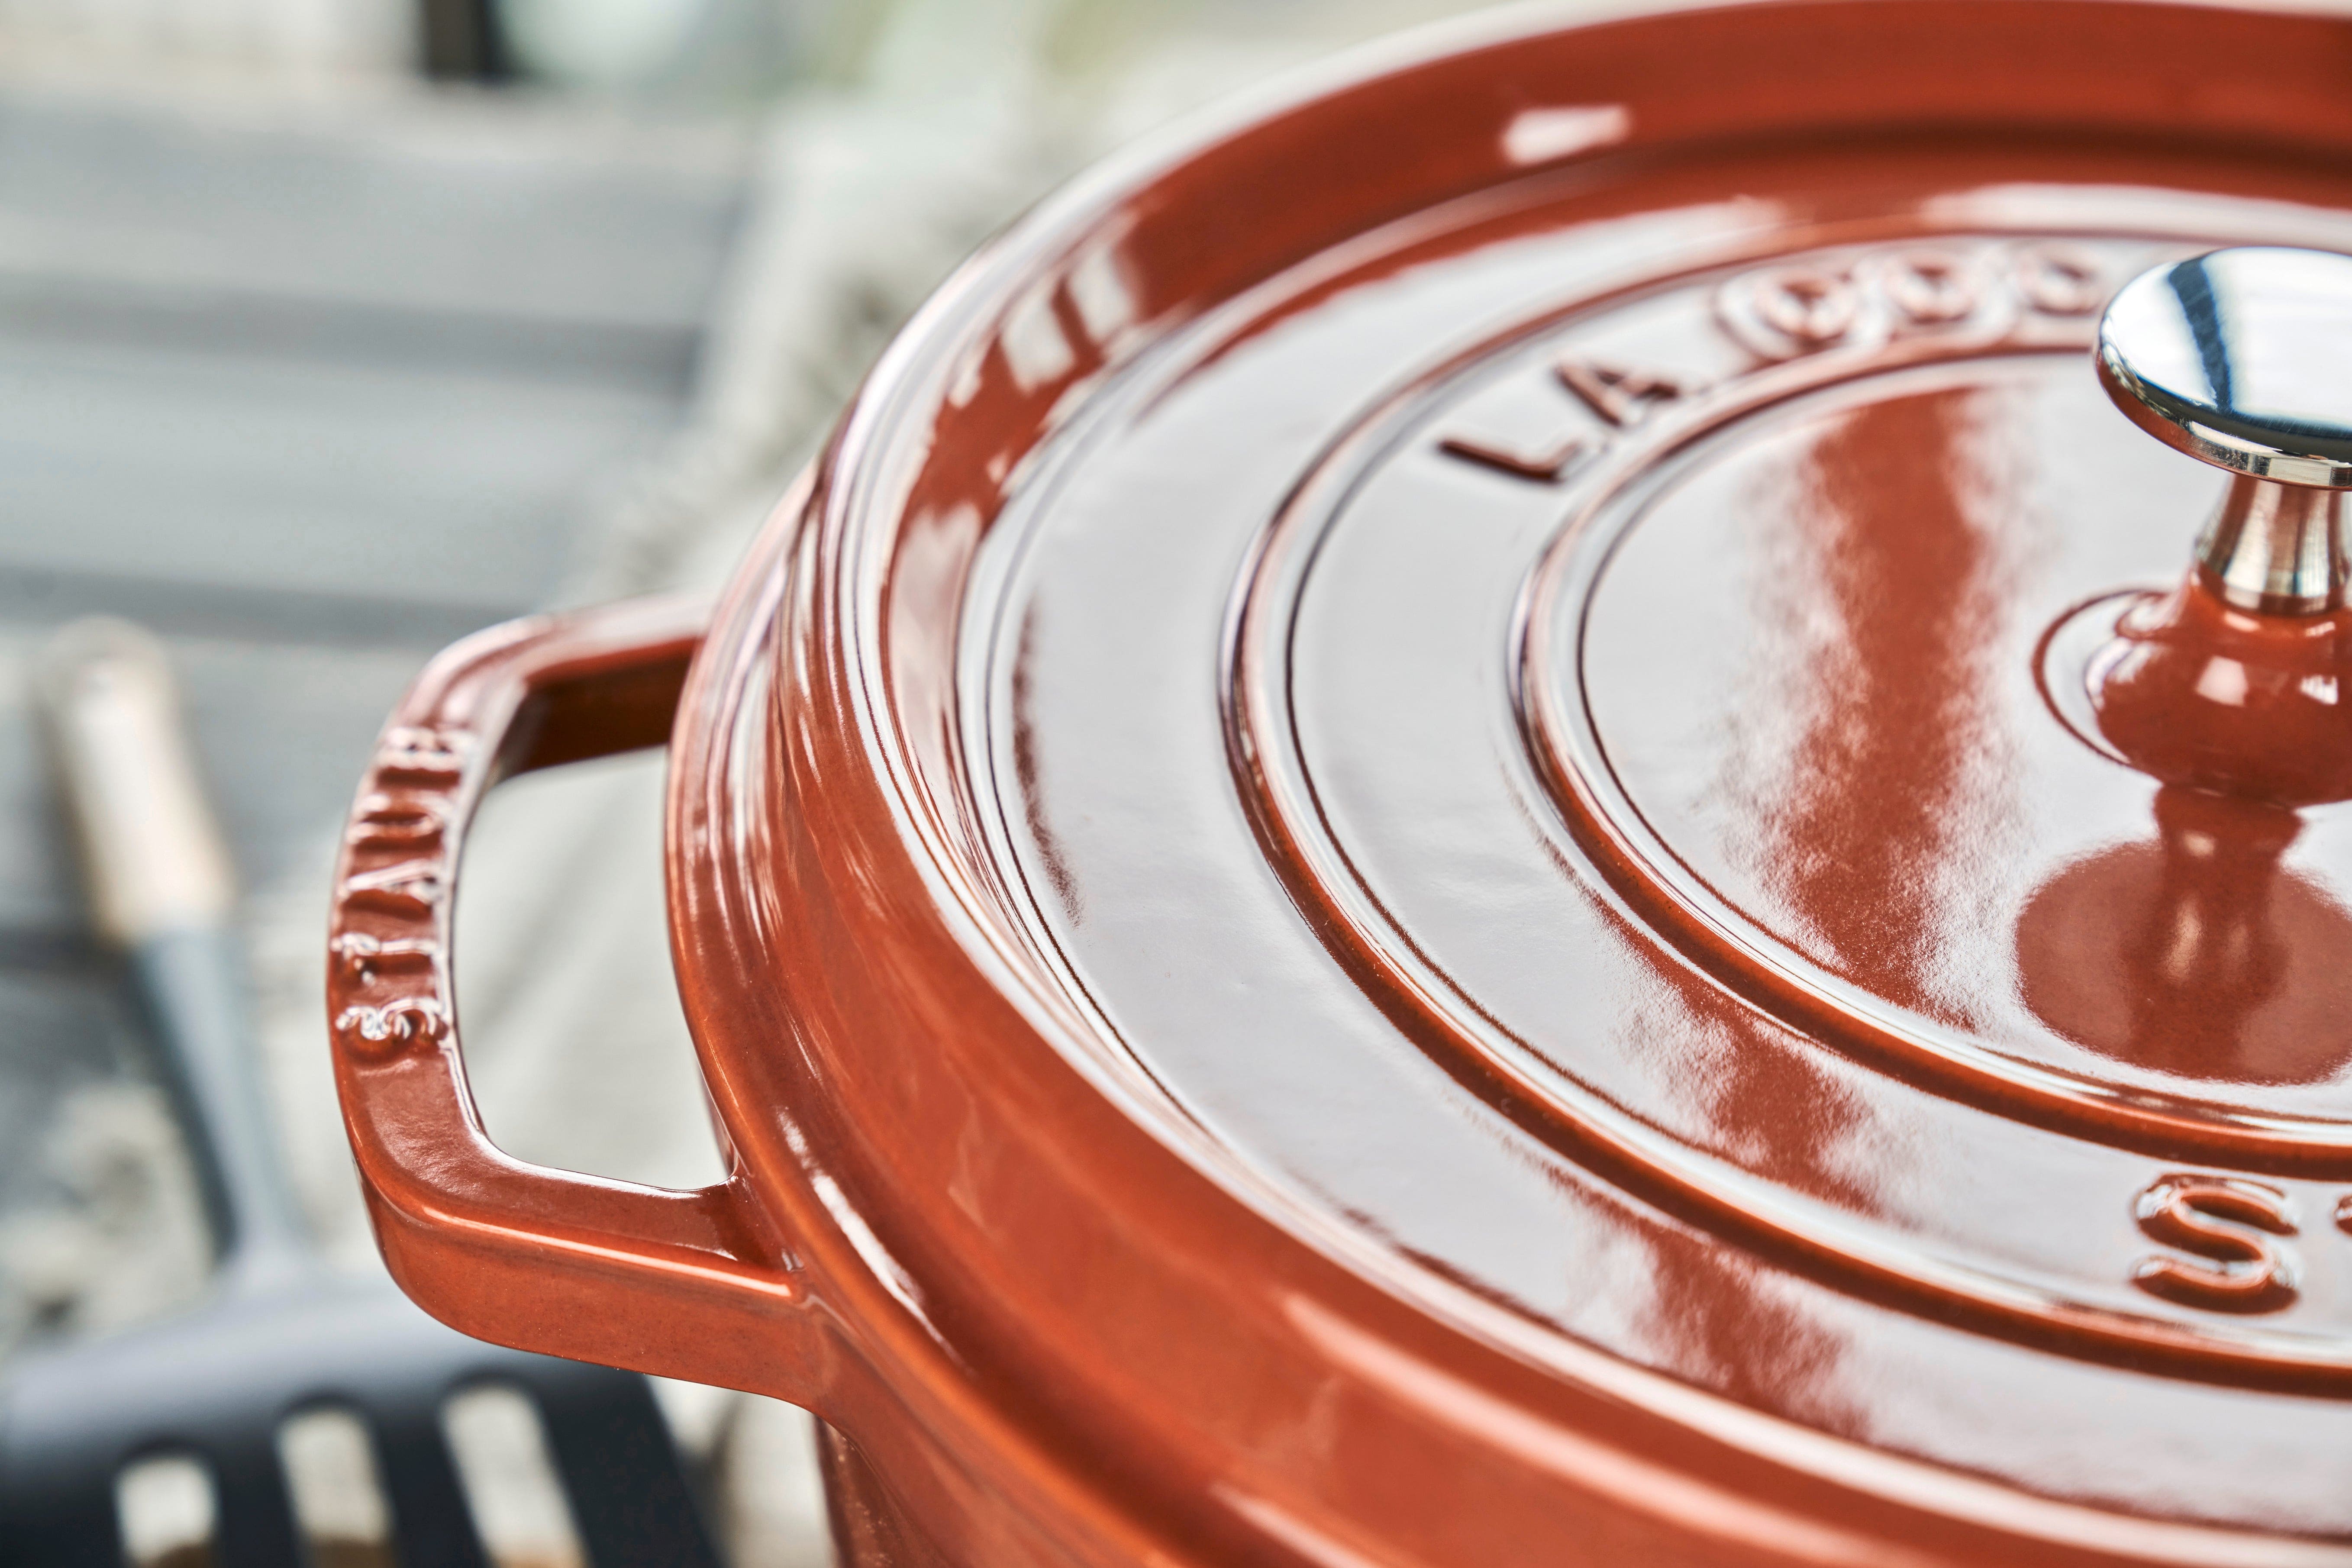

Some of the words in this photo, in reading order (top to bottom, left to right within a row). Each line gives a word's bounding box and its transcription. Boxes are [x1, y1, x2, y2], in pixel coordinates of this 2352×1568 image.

[1436, 356, 1683, 484] LA
[331, 726, 467, 1049] STAUB
[2130, 1171, 2352, 1317] S
